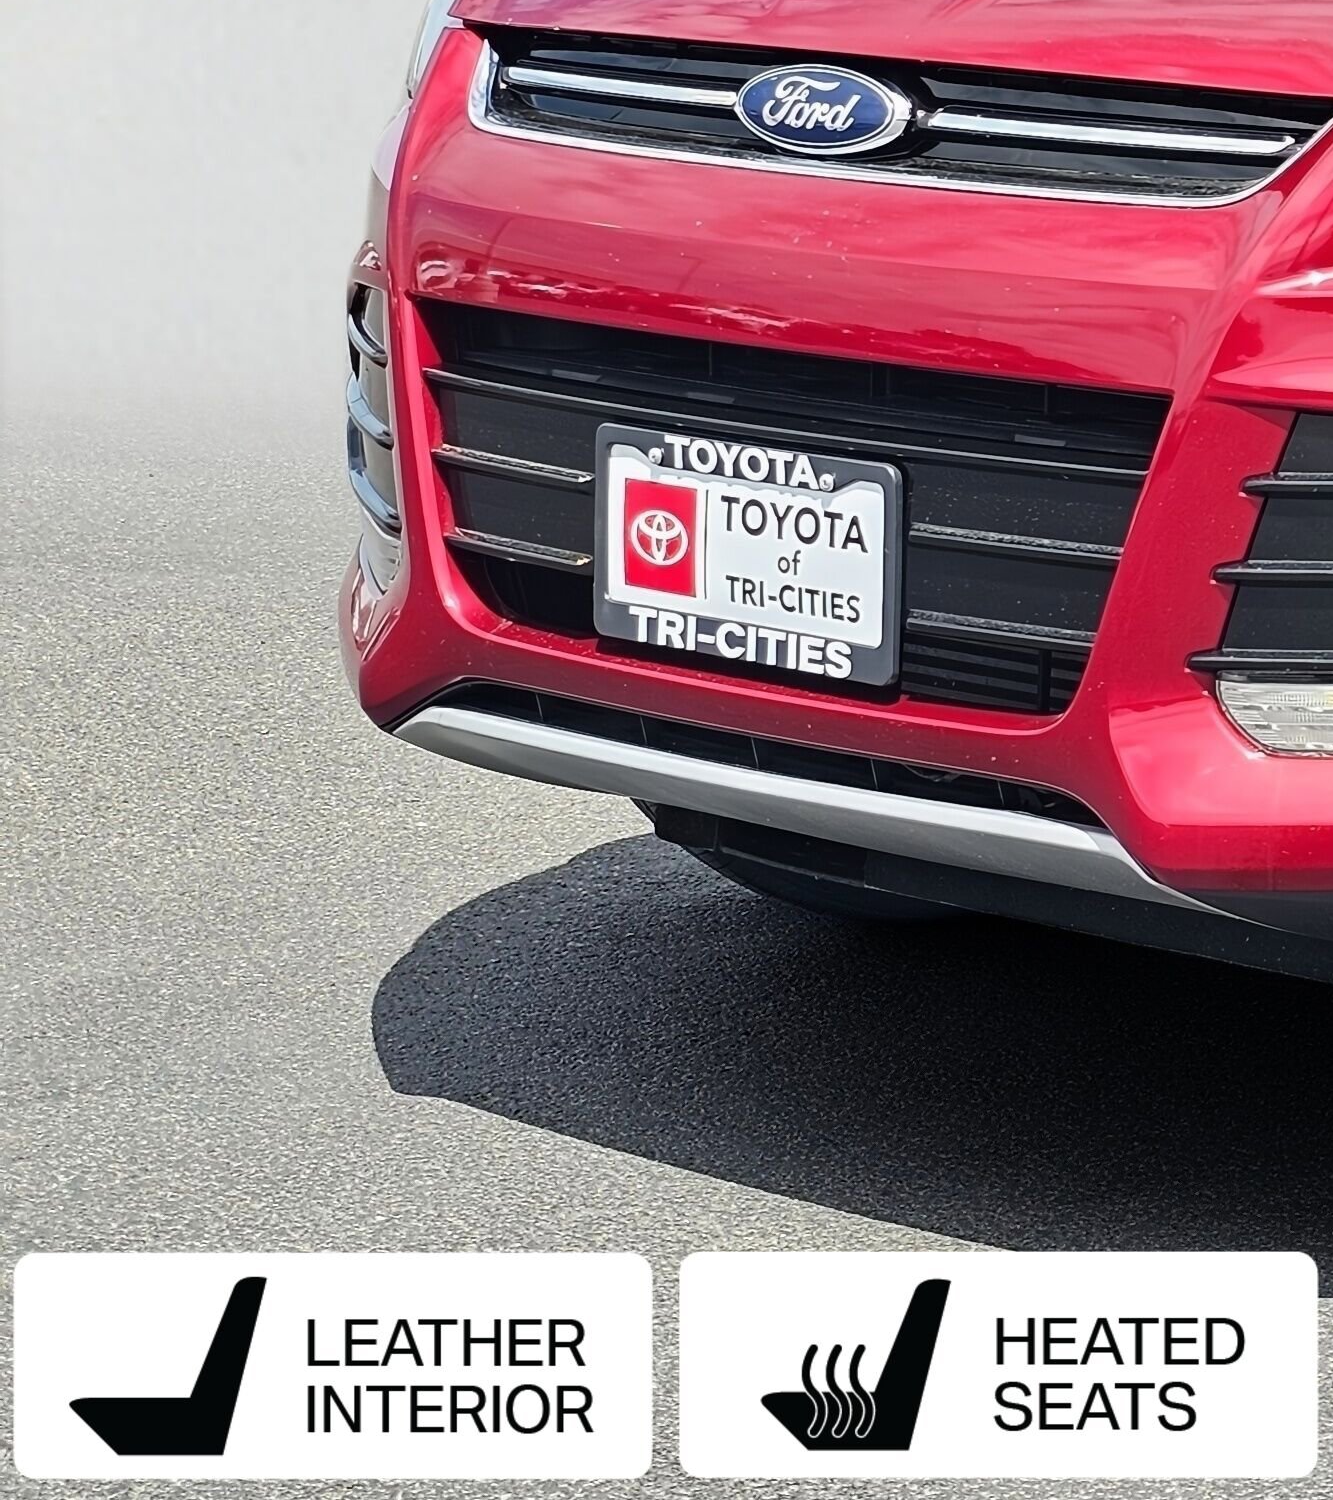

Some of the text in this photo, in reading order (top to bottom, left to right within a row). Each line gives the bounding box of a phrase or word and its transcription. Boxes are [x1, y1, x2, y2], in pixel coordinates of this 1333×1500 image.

[762, 76, 862, 132] Ford
[664, 435, 820, 491] TOYOTA
[721, 496, 868, 553] TOYOTA
[777, 550, 801, 576] of
[725, 575, 860, 623] TRI-CITIES
[629, 606, 852, 679] TRI-CITIES
